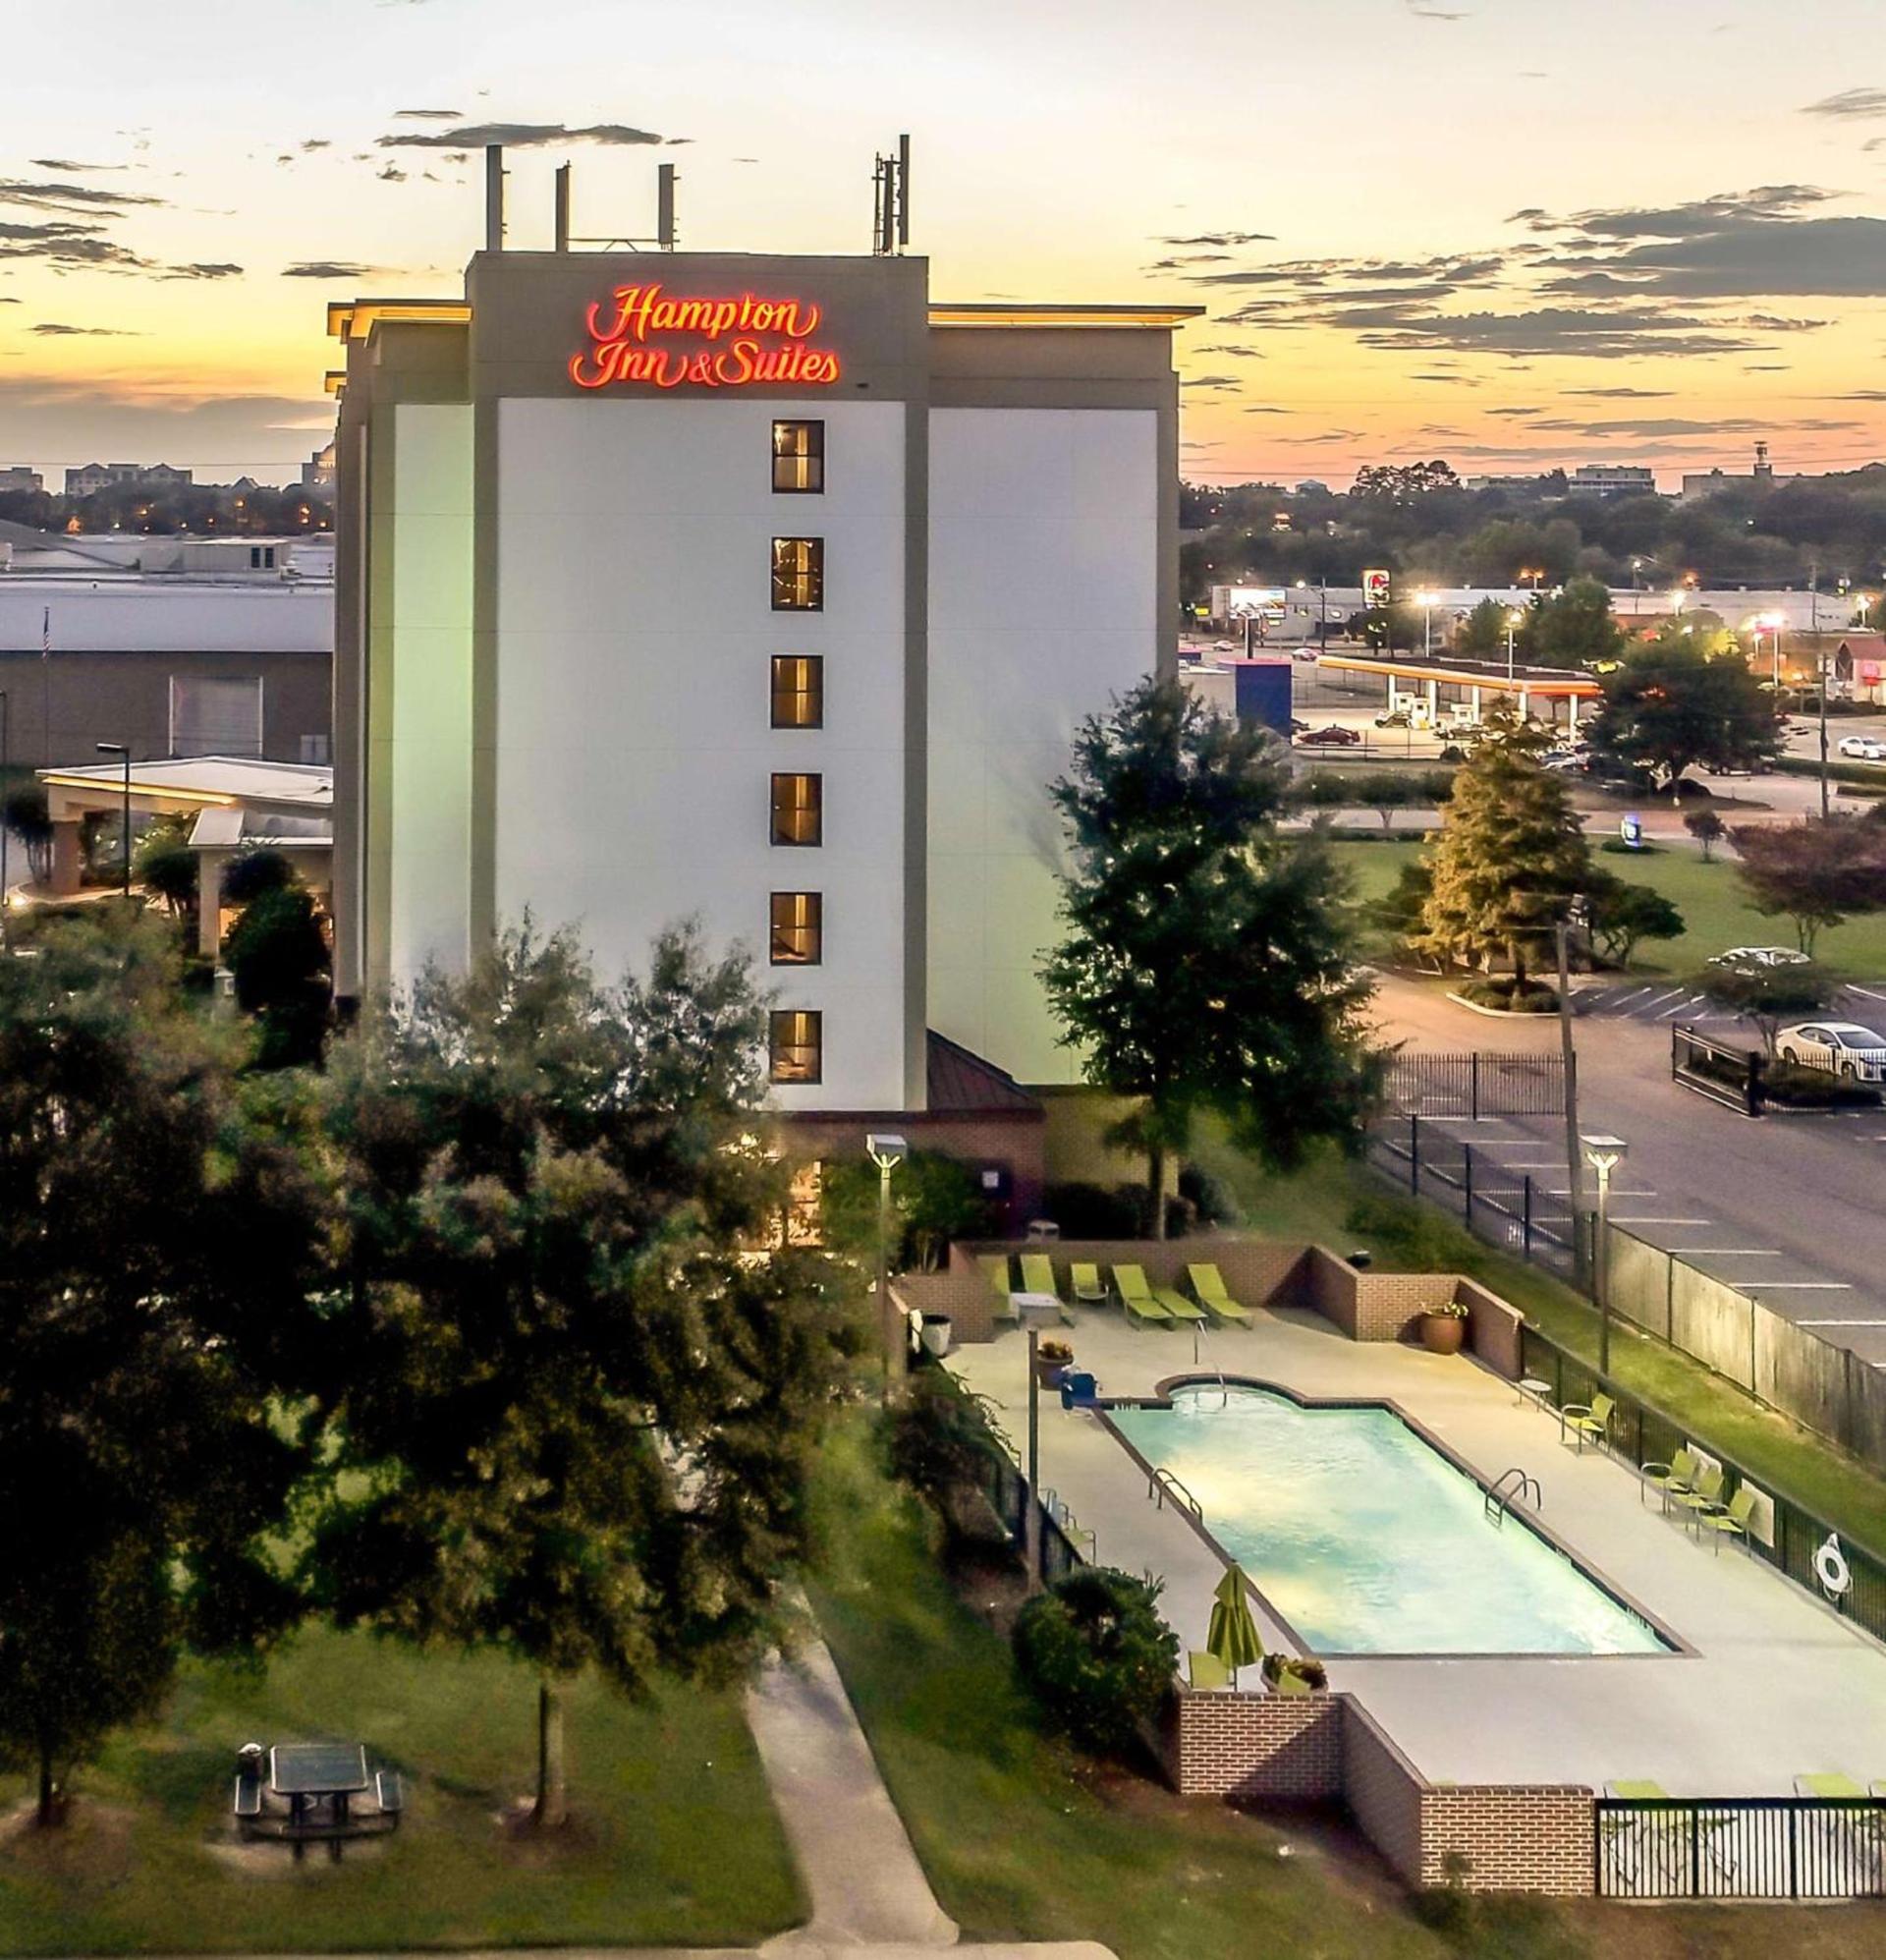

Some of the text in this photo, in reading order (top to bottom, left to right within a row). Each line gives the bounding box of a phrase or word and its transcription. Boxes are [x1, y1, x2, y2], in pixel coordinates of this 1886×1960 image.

[586, 283, 821, 342] Hampton
[570, 338, 840, 387] Inn & Suites
